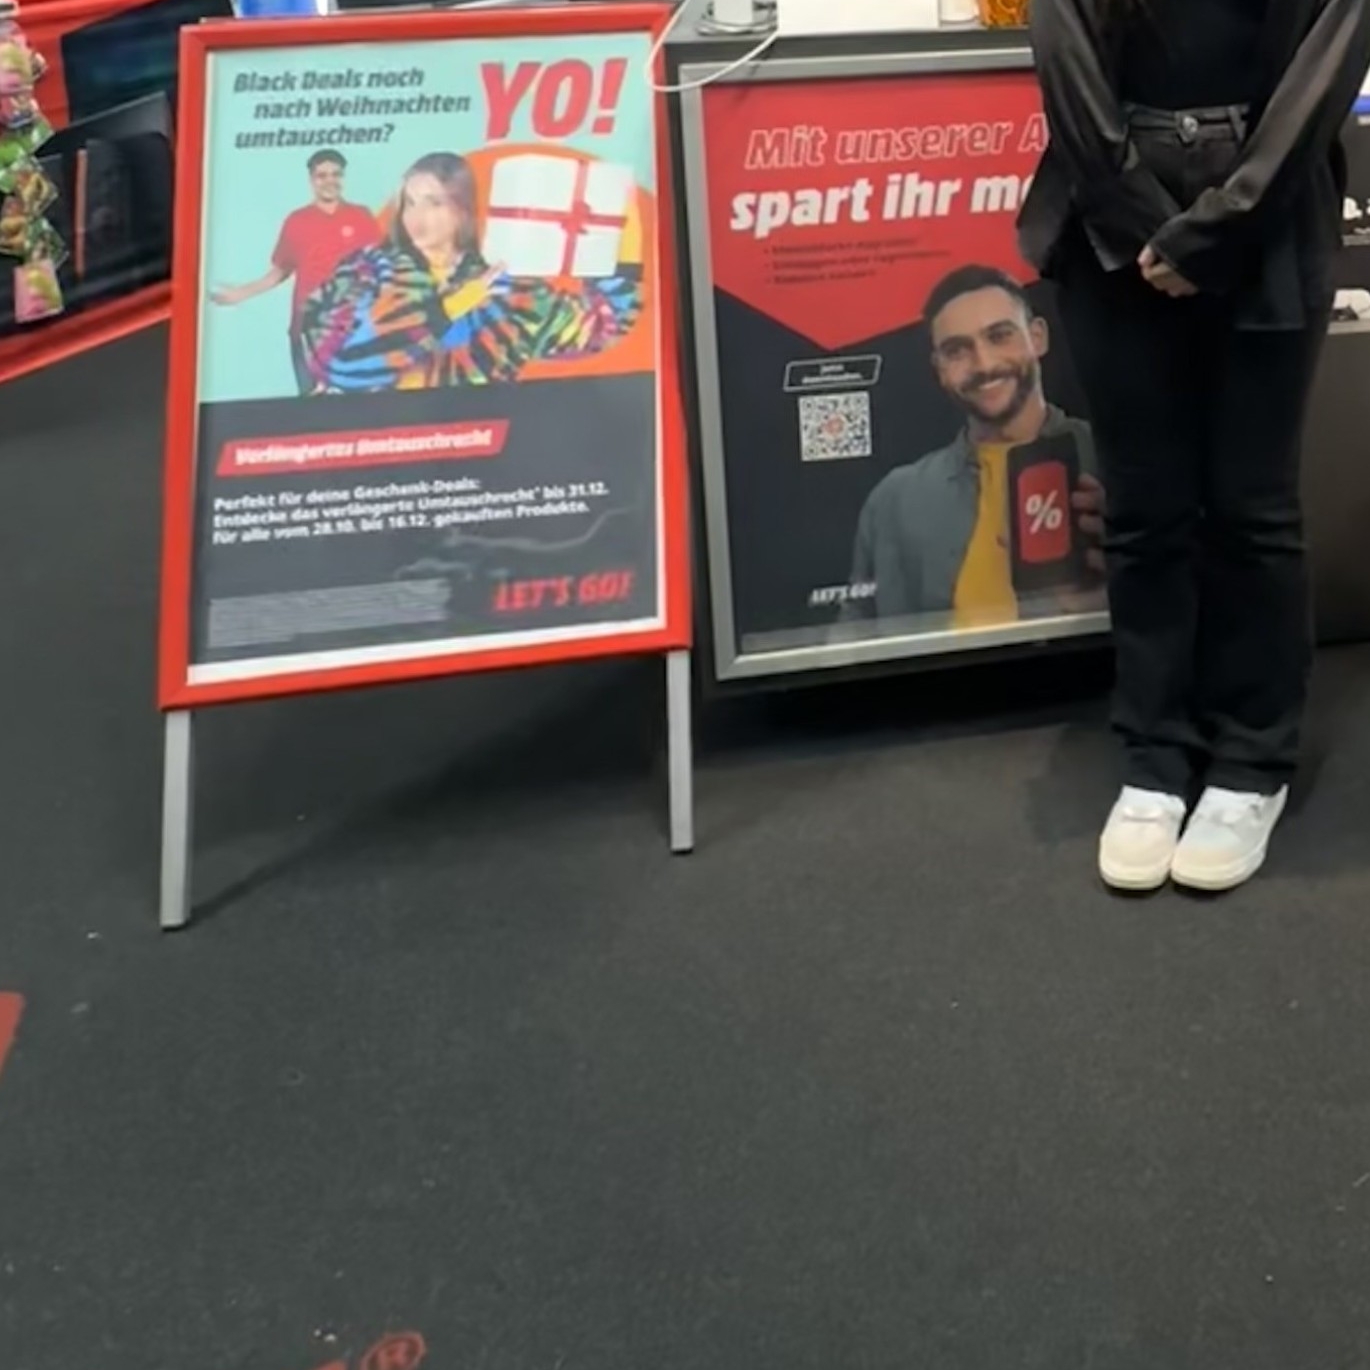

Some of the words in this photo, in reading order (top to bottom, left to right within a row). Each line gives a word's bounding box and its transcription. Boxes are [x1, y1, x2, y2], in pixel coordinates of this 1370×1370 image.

[234, 70, 297, 93] Black
[301, 67, 363, 91] Deals
[366, 66, 424, 88] noch
[480, 57, 628, 141] YO!
[254, 97, 311, 120] nach
[316, 94, 471, 118] Weihnachten
[235, 123, 395, 150] umtauschen?
[744, 125, 827, 170] Mit
[835, 119, 1011, 165] unserer
[729, 176, 873, 238] spart
[882, 171, 963, 221] ihr
[214, 493, 275, 510] Perfekt
[278, 490, 303, 505] für
[306, 489, 350, 504] deine
[353, 476, 481, 500] Geschenk-Deals:
[214, 510, 287, 528] Entdecke
[290, 507, 319, 521] das
[321, 499, 414, 519] verlängerte
[543, 485, 565, 500] bis
[568, 481, 610, 498] 31.12.
[213, 530, 238, 545] für
[241, 526, 271, 542] alle
[273, 525, 310, 540] vom
[360, 517, 383, 532] bis
[433, 507, 514, 528] gekauften
[516, 500, 591, 518] Produkte.
[492, 574, 572, 614] LET'S
[578, 570, 636, 604] GO!
[807, 585, 848, 608] LET'S
[849, 582, 878, 599] GO!
